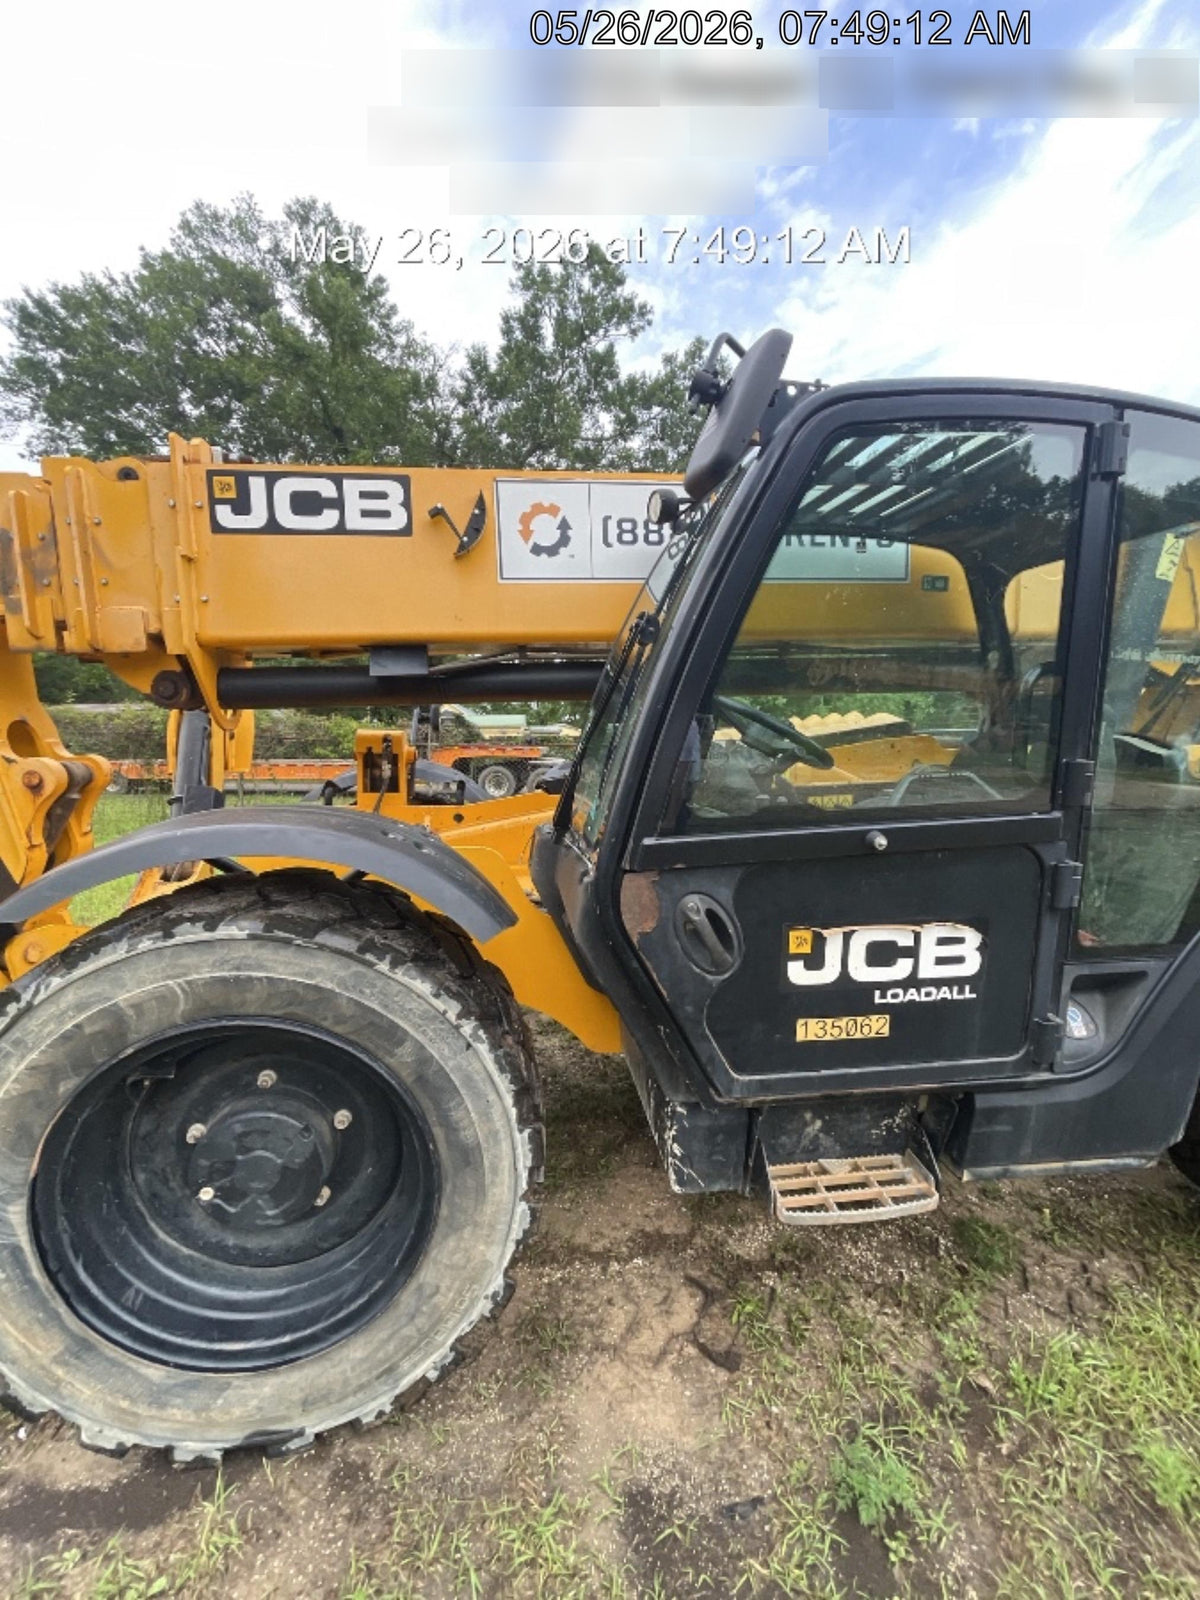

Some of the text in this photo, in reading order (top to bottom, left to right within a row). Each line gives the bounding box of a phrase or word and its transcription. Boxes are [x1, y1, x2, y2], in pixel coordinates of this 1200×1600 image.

[214, 475, 408, 531] JCB
[602, 515, 675, 548] (88
[787, 924, 983, 986] JCB
[874, 985, 977, 1004] LOADALL
[799, 1015, 890, 1039] 135062
